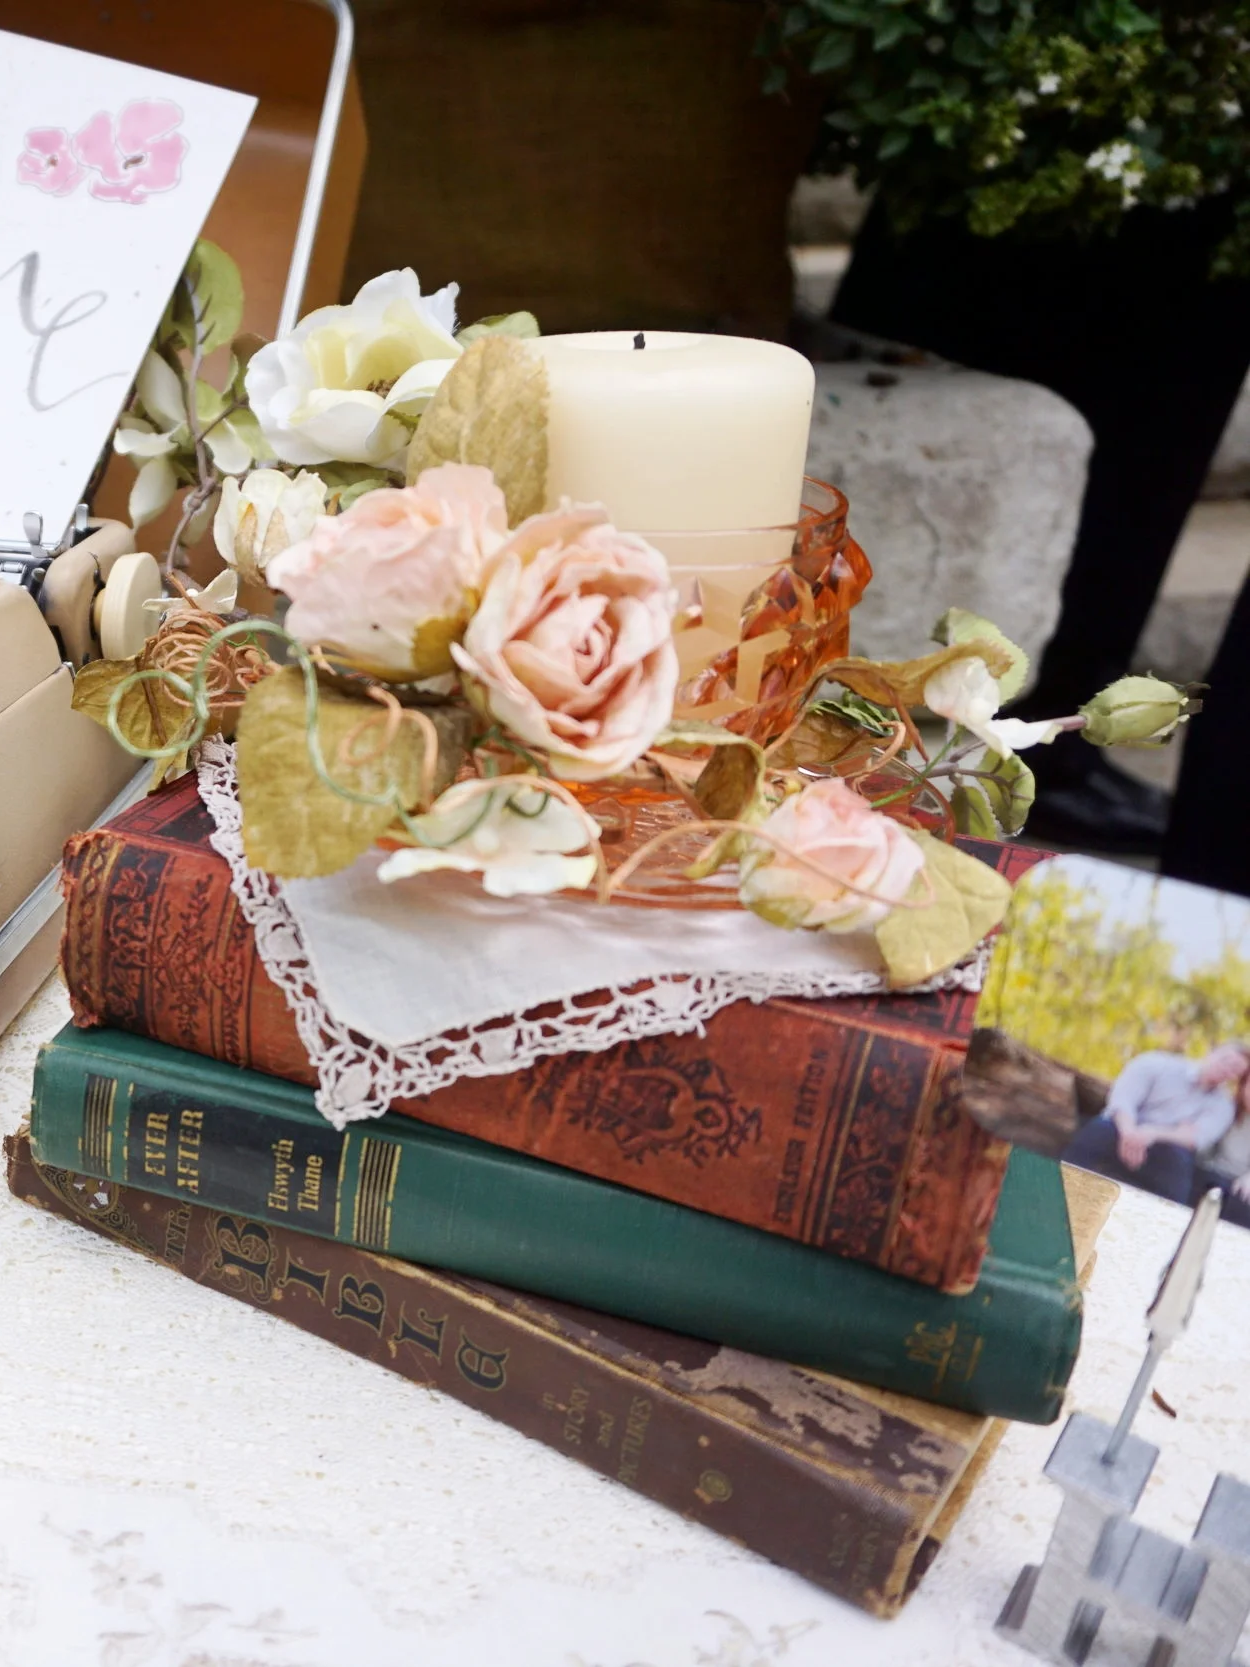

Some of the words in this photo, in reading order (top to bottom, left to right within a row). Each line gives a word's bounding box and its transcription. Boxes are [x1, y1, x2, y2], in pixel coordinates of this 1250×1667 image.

[145, 1112, 169, 1176] EVER
[177, 1109, 203, 1194] AFTER
[268, 1138, 295, 1212] Elswyth
[297, 1155, 323, 1211] Thane
[564, 1384, 589, 1445] STORY
[597, 1410, 615, 1448] and
[618, 1396, 651, 1485] PICTURES
